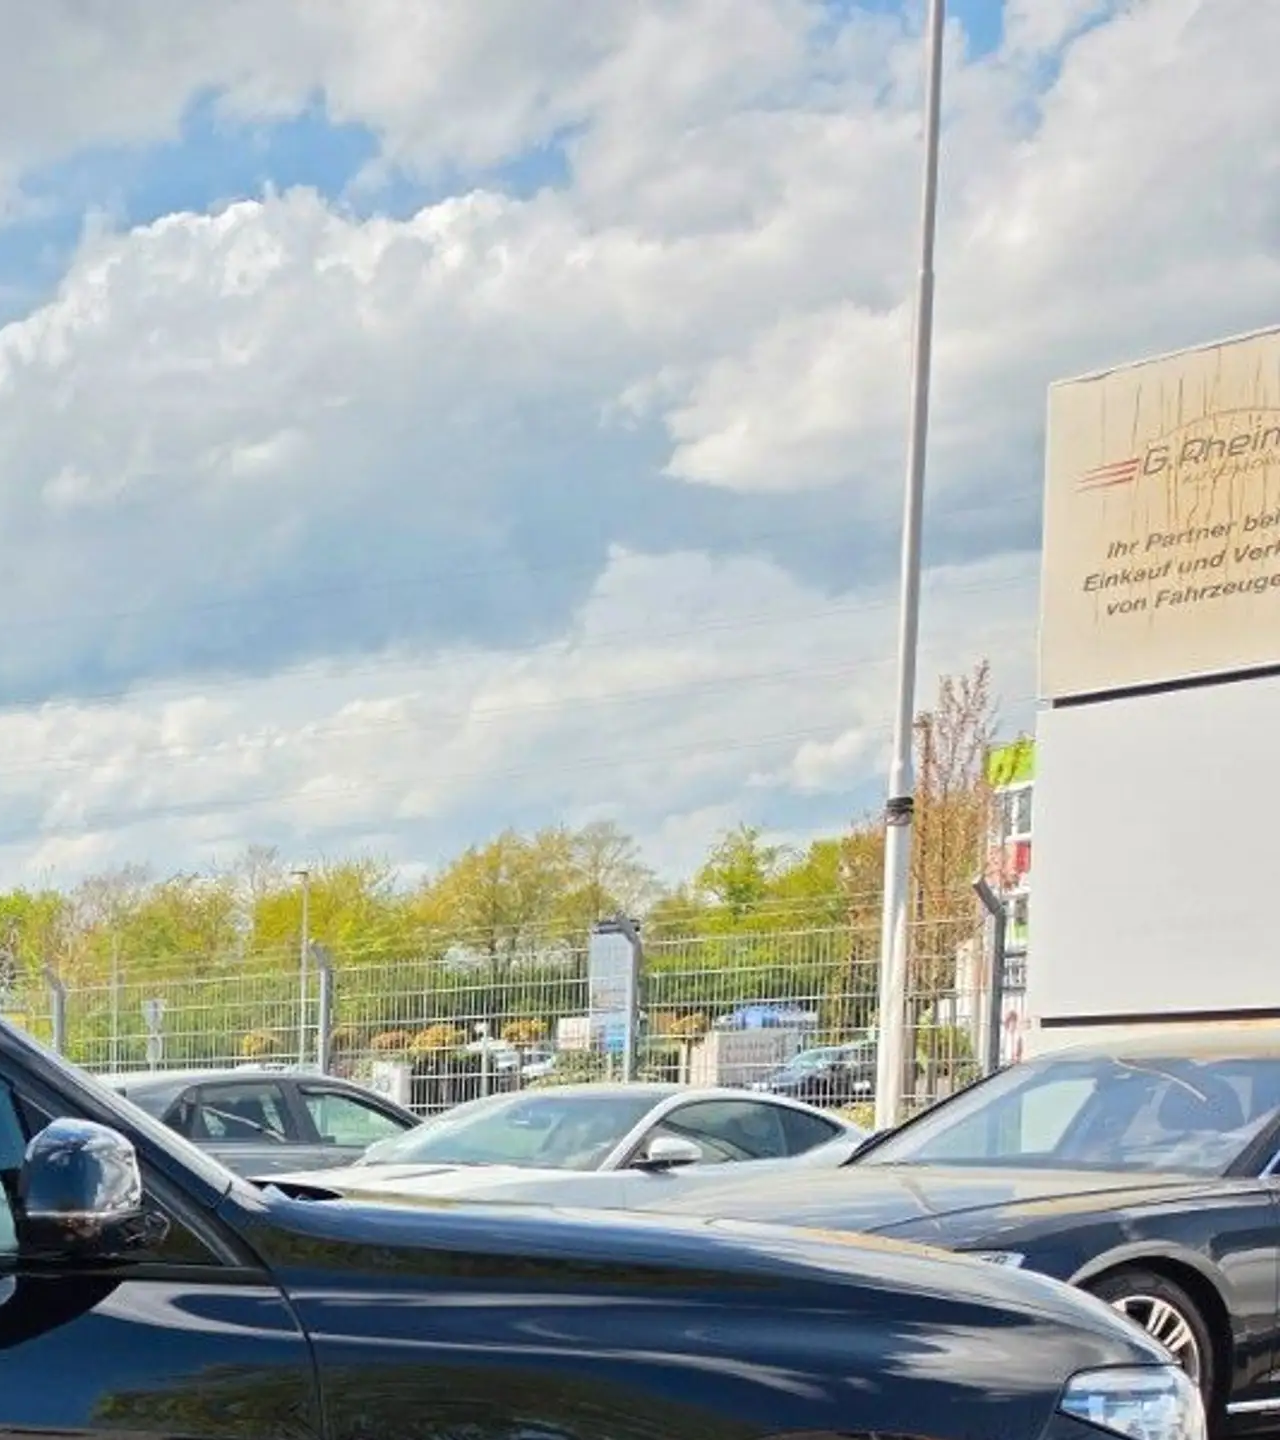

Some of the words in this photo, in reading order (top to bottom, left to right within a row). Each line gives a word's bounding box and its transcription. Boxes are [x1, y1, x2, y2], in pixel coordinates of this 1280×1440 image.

[1107, 540, 1139, 559] Ihr
[1146, 521, 1237, 552] Partner
[1083, 560, 1171, 592] Einkauf
[1177, 550, 1226, 574] und
[1107, 598, 1147, 616] von
